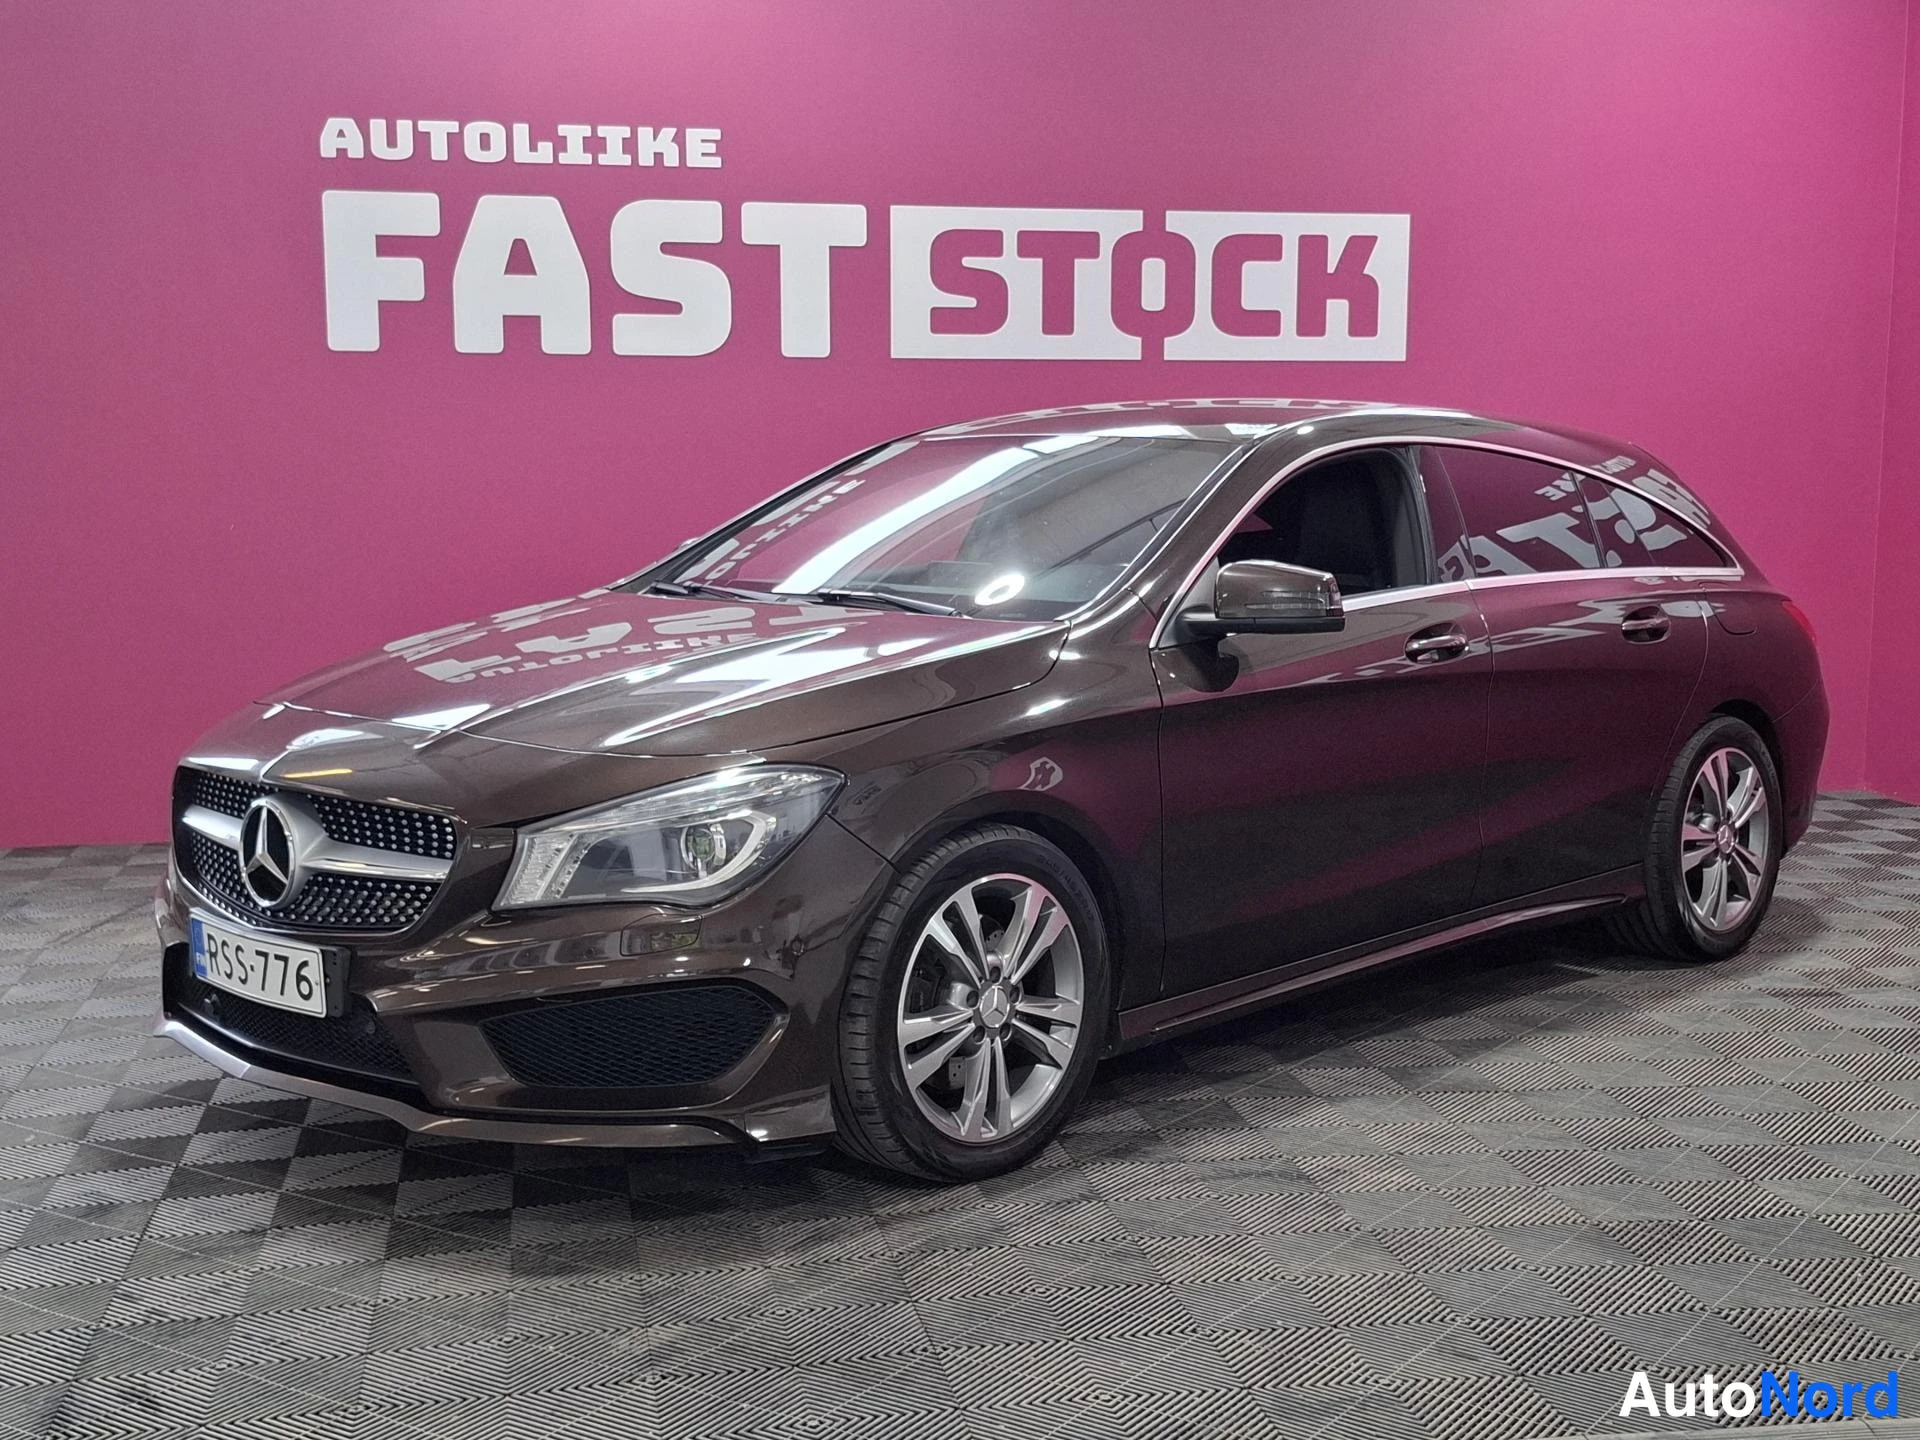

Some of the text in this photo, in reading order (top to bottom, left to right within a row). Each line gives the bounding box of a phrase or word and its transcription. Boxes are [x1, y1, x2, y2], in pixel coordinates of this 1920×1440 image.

[320, 117, 722, 168] AUTOLIIKE
[321, 190, 1380, 358] FAST STOCK
[207, 933, 313, 1000] RSS-776
